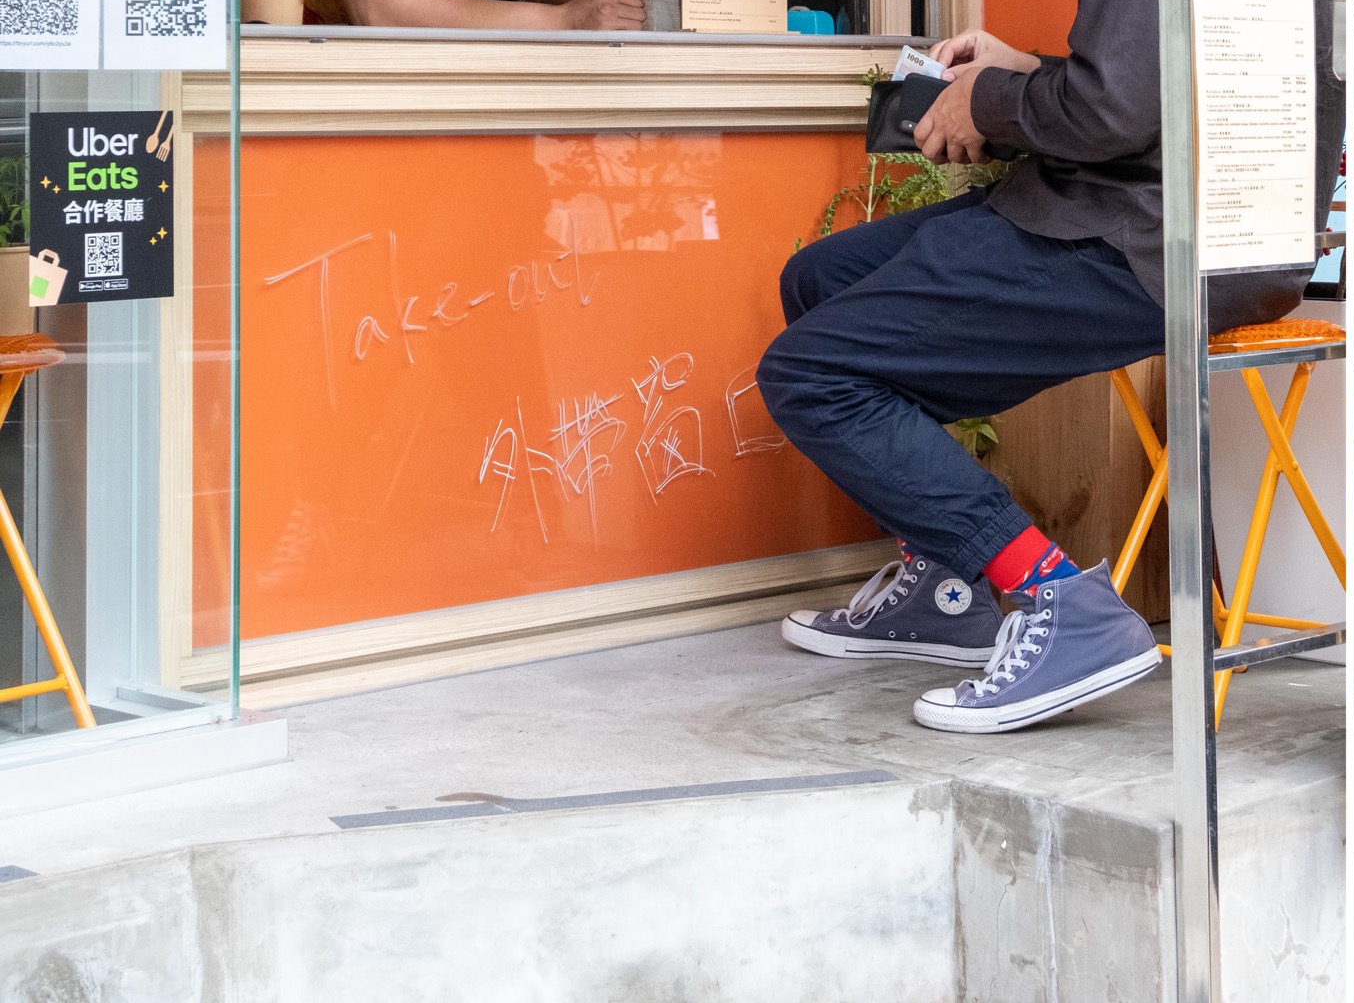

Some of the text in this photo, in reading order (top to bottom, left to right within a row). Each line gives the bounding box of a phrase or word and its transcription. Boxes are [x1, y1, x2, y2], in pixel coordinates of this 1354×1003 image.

[906, 52, 925, 67] 1000
[67, 127, 139, 157] Uber
[68, 161, 139, 191] Eats
[62, 198, 145, 225] 合作餐廳
[264, 212, 601, 412] Take-out
